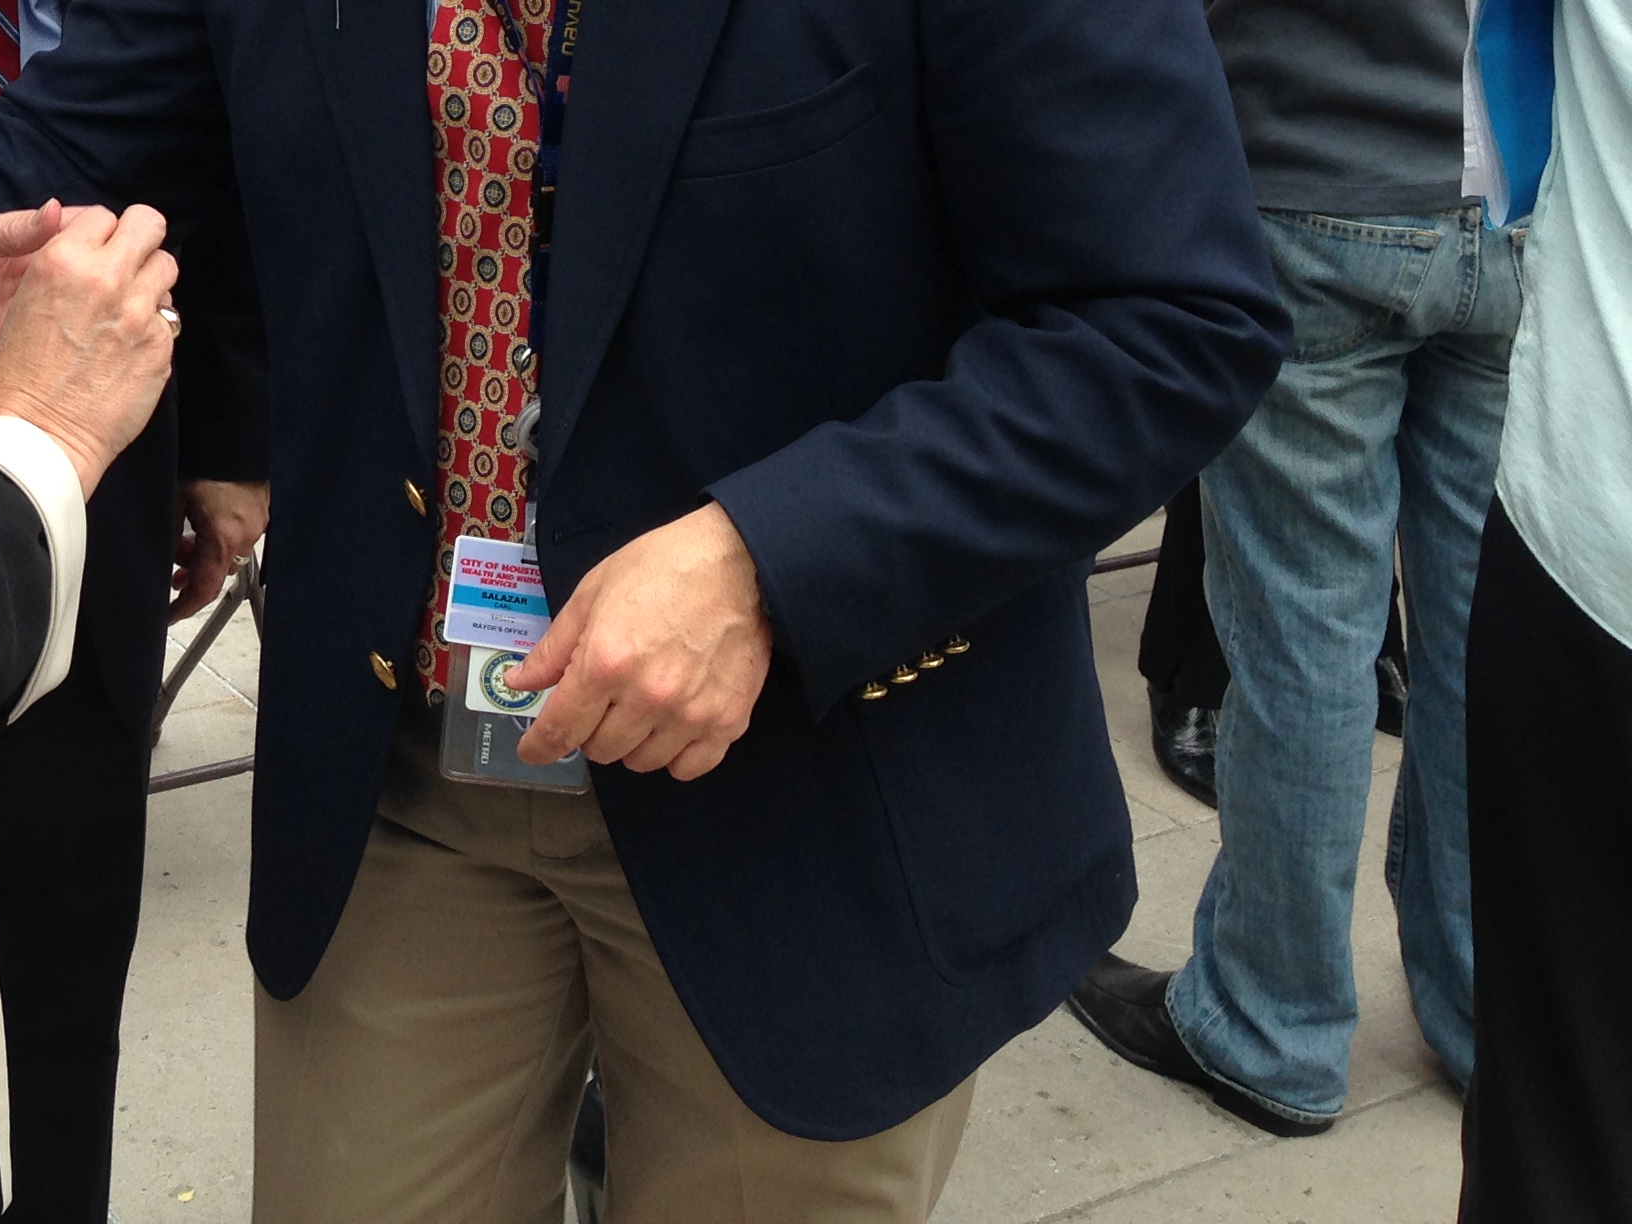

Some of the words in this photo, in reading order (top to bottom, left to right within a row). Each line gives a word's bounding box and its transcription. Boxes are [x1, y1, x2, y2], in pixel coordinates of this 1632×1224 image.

[460, 558, 483, 568] CITY
[485, 561, 499, 570] OF
[462, 567, 494, 578] HEALTH
[496, 572, 515, 580] AND
[480, 577, 518, 589] SERVICES
[481, 591, 528, 605] SALAZAR
[493, 602, 513, 611] CARL
[472, 622, 504, 633] MAYOR'S
[504, 627, 530, 637] OFFICE
[479, 722, 493, 765] METRO
